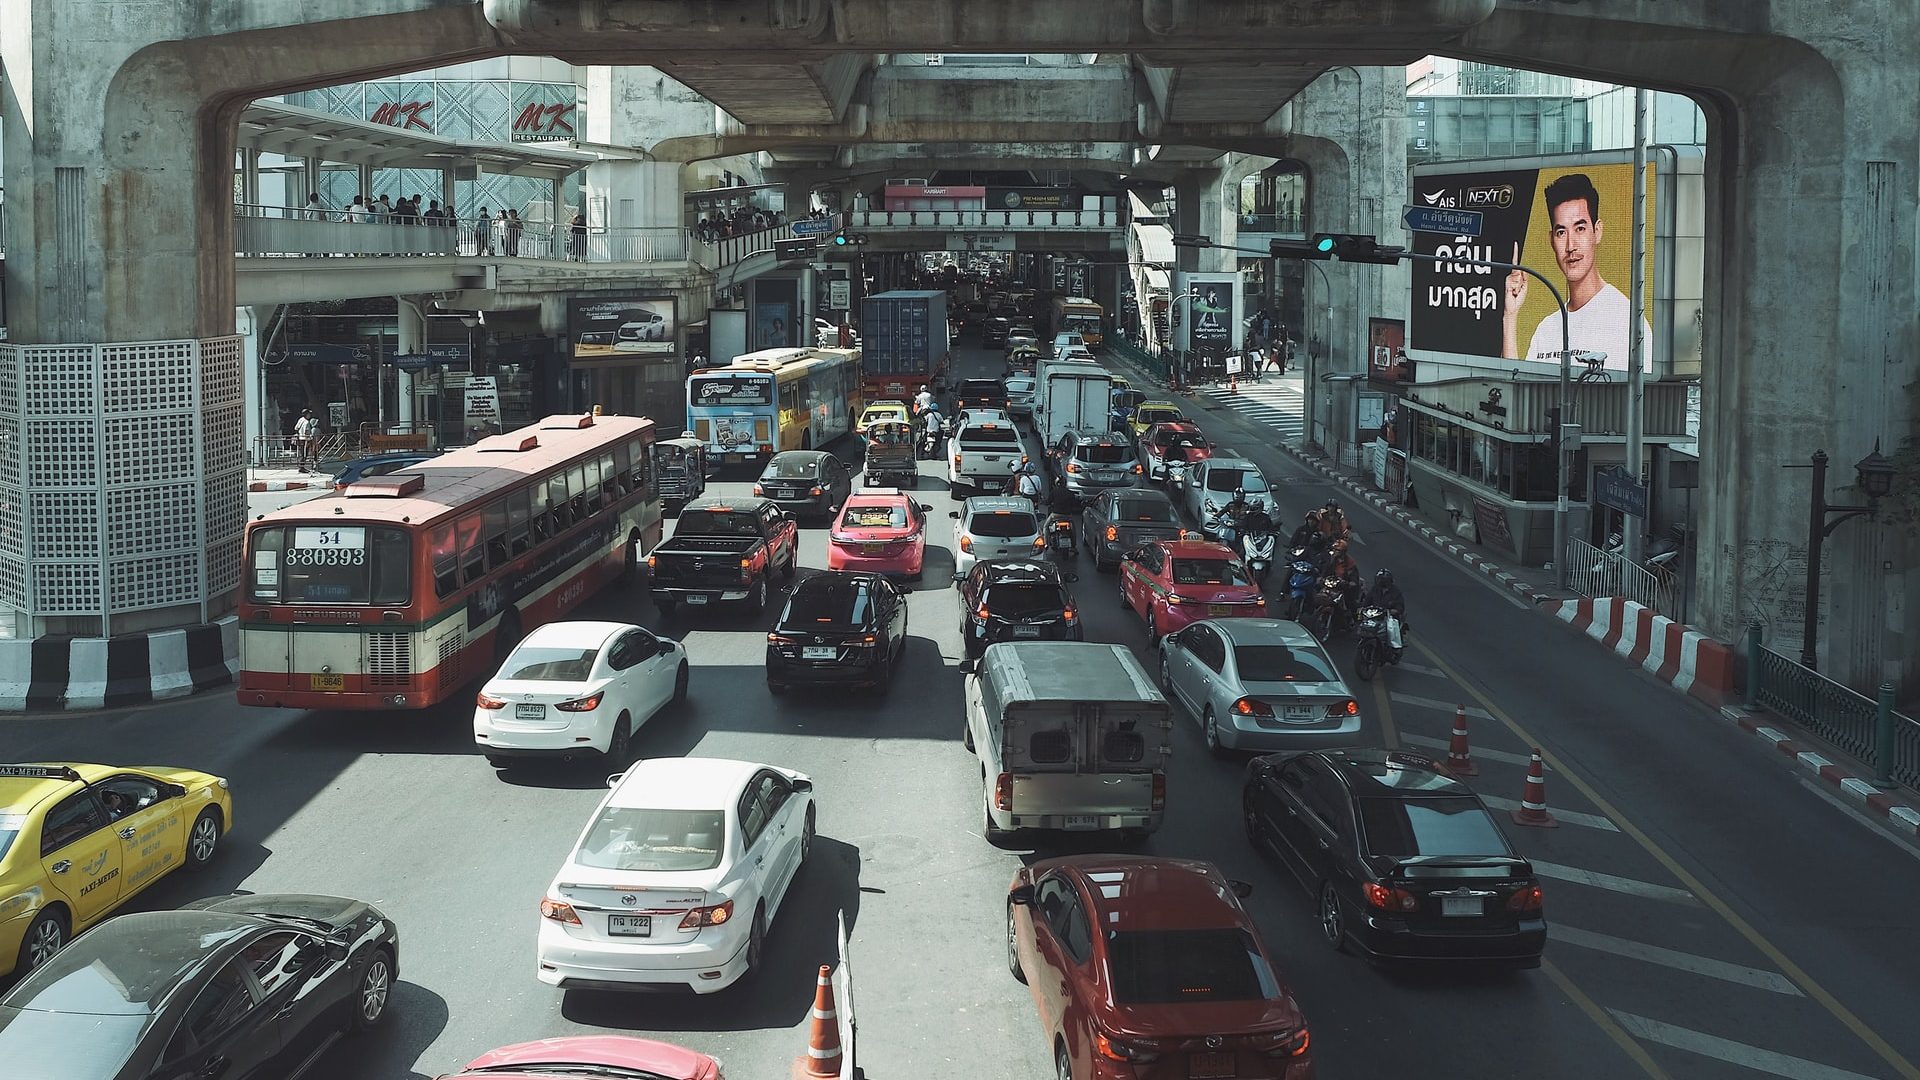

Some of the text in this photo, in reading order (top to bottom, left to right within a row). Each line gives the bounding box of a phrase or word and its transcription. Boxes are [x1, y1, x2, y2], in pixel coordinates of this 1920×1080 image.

[370, 101, 431, 130] MK
[513, 102, 576, 132] MK
[1438, 197, 1456, 208] AIS
[1429, 286, 1497, 320] มากสุด
[319, 531, 341, 545] 54
[286, 548, 365, 566] 8-80393
[80, 867, 120, 897] TAXI-METER
[630, 918, 649, 927] 1222
